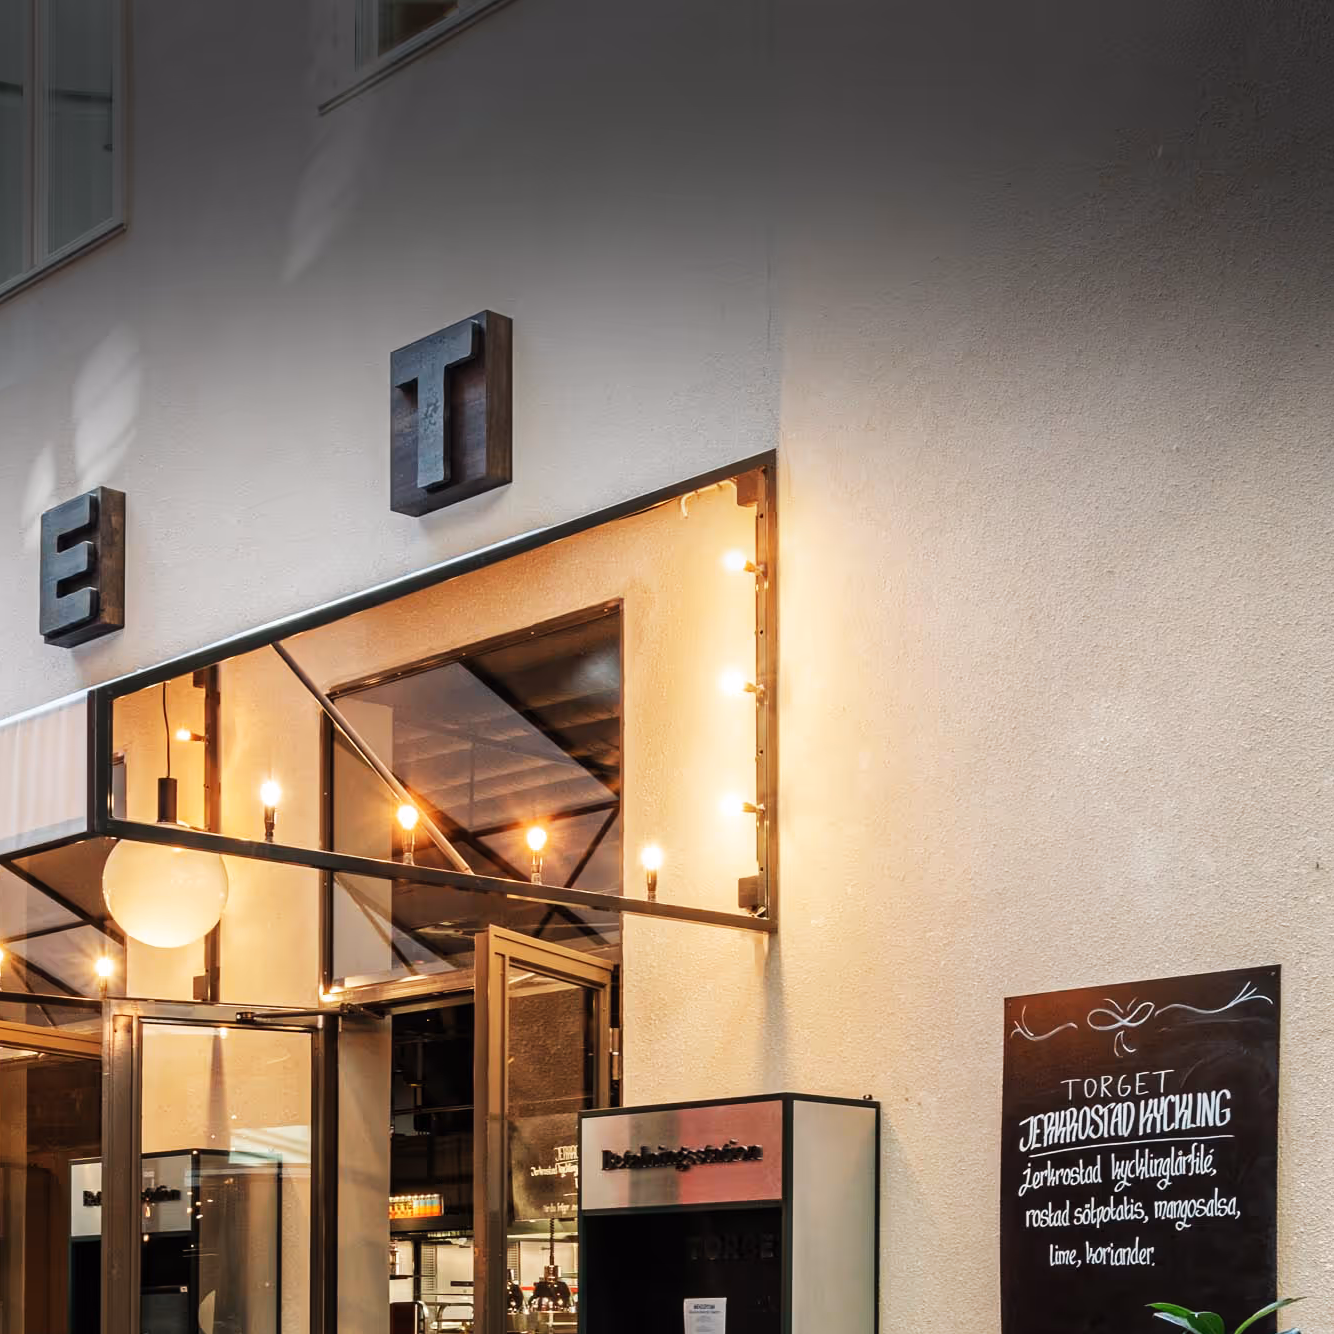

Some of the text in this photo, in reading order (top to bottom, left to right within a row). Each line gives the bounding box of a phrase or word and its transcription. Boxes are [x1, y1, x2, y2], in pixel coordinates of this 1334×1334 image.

[1060, 1069, 1175, 1100] TORGET
[1018, 1088, 1231, 1152] JERKROSTAD KYCKLING
[1018, 1142, 1217, 1196] jerkrostad kycklinglårfilé,
[1025, 1187, 1241, 1231] rostad sötpotatis, mangosalsa,
[1049, 1236, 1155, 1268] lime, koriander.
